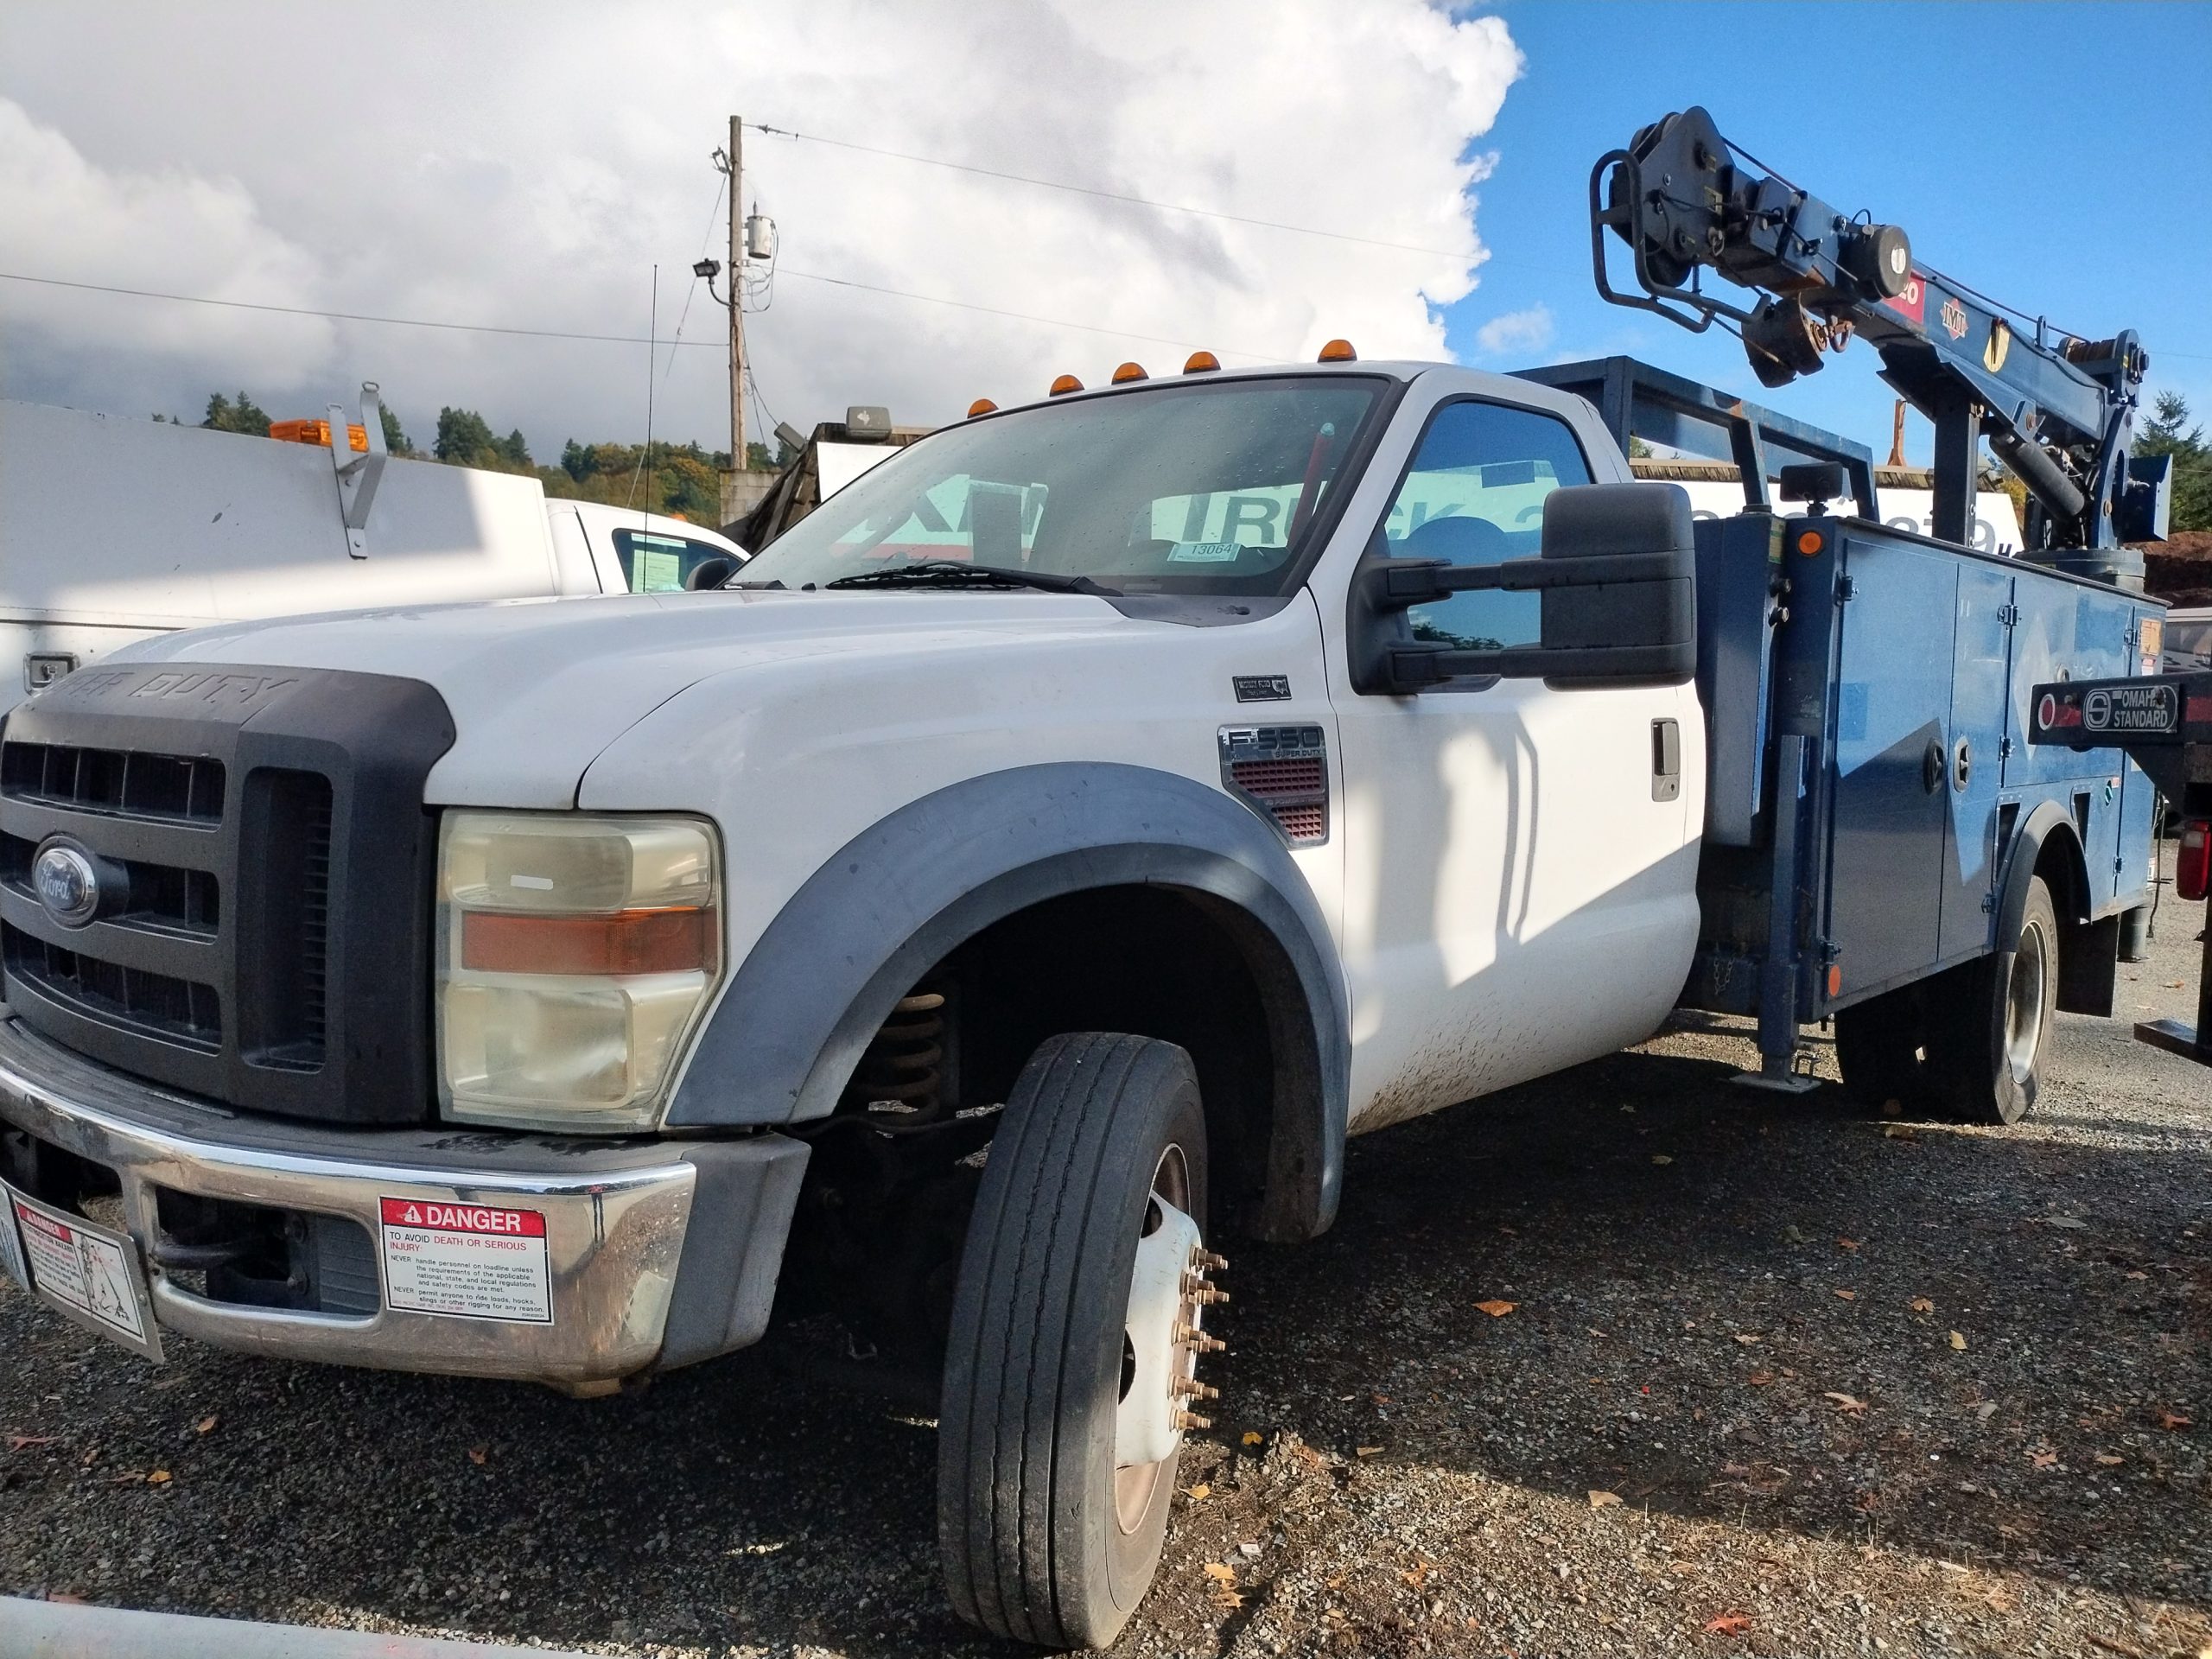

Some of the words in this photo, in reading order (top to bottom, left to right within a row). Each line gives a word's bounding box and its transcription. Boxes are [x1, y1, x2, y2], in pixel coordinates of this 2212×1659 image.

[1944, 303, 1966, 334] IMT
[1192, 543, 1233, 555] 13064
[128, 672, 300, 703] DUTY
[2113, 710, 2168, 728] STANDARD
[41, 858, 71, 899] Ford
[427, 1206, 521, 1231] DANGER
[404, 1234, 429, 1243] AVOID
[434, 1236, 463, 1246] DEATH
[485, 1241, 526, 1250] SERIOUS
[429, 1268, 470, 1276] requirements
[439, 1261, 470, 1269] personnel
[472, 1301, 490, 1310] rigging
